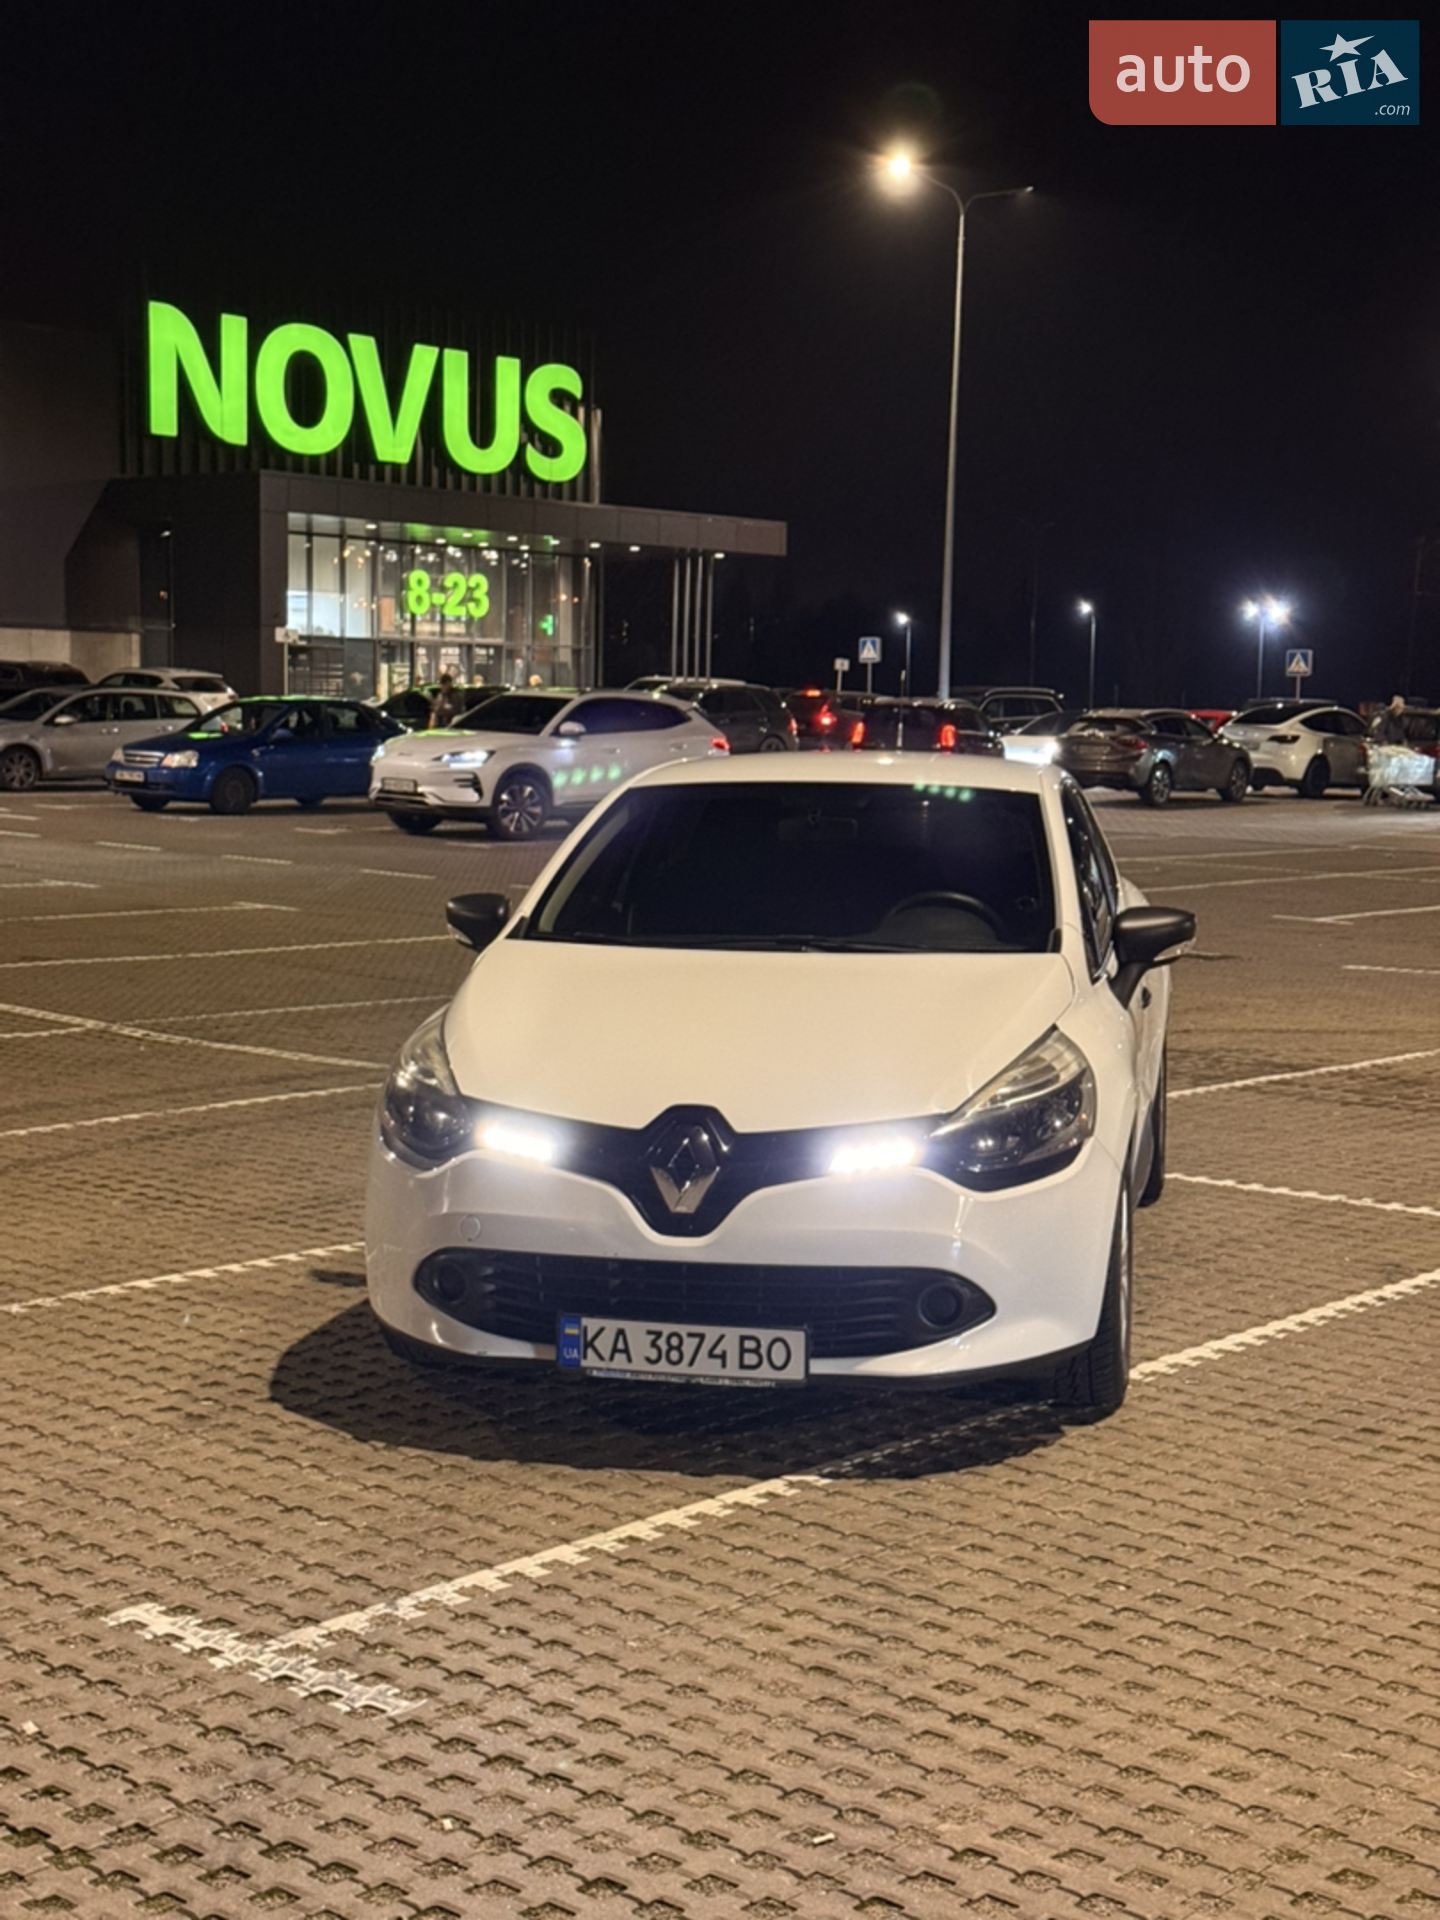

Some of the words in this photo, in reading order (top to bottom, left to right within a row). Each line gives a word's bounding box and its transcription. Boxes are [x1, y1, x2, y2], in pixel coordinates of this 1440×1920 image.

[148, 300, 588, 483] NOVUS
[408, 569, 490, 618] 8-23
[563, 1347, 580, 1359] UA
[582, 1325, 633, 1364] KA
[644, 1329, 727, 1369] 3874
[738, 1334, 792, 1372] BO
